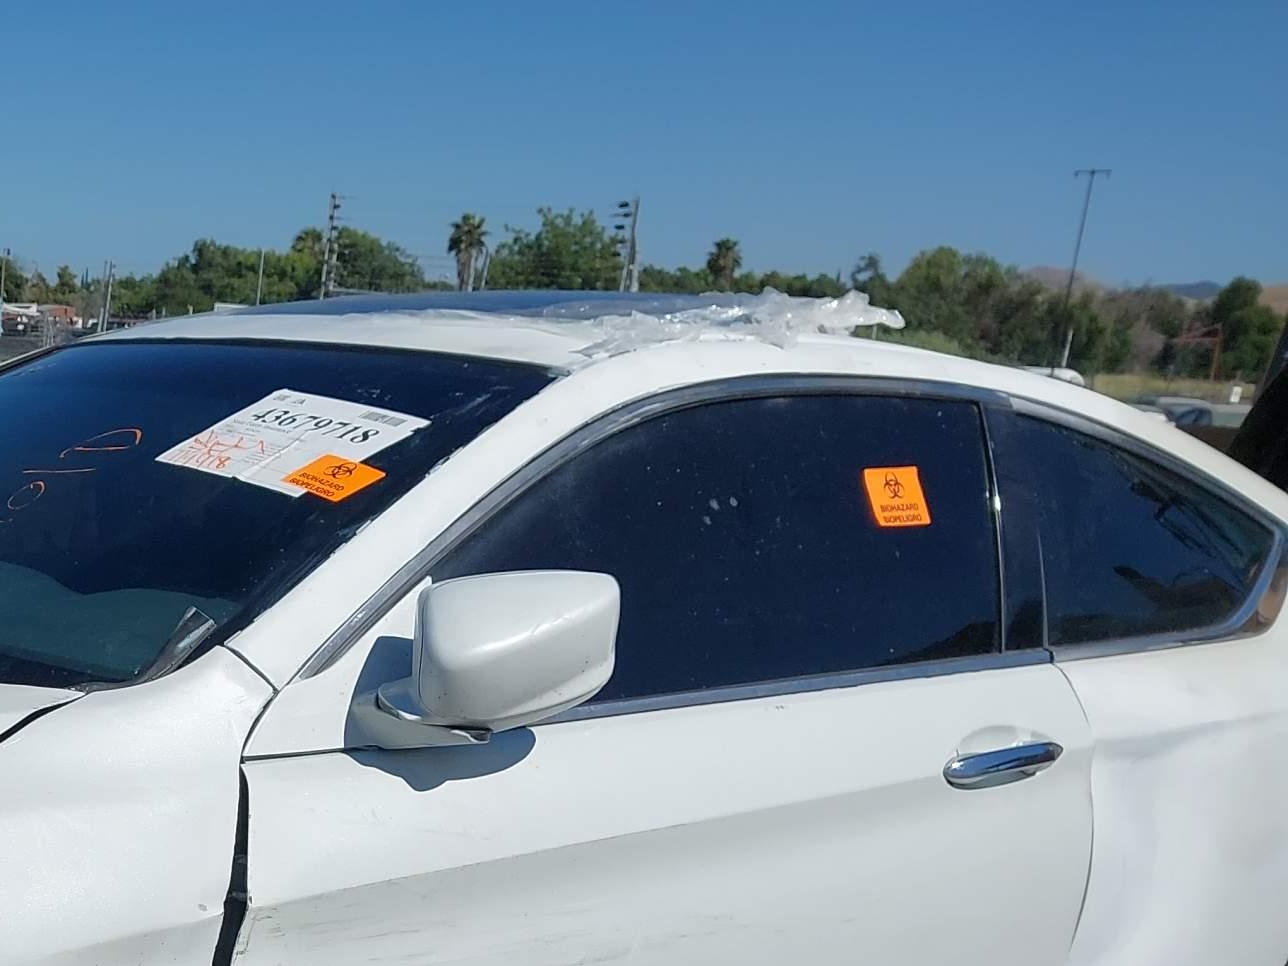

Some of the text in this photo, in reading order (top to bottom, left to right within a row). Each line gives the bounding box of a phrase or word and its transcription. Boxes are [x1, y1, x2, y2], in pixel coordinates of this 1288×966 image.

[251, 407, 380, 445] 43679718
[289, 477, 336, 498] BIOPELIGRO
[298, 471, 345, 492] BIOHAZARD
[880, 503, 919, 513] BIOHAZARD
